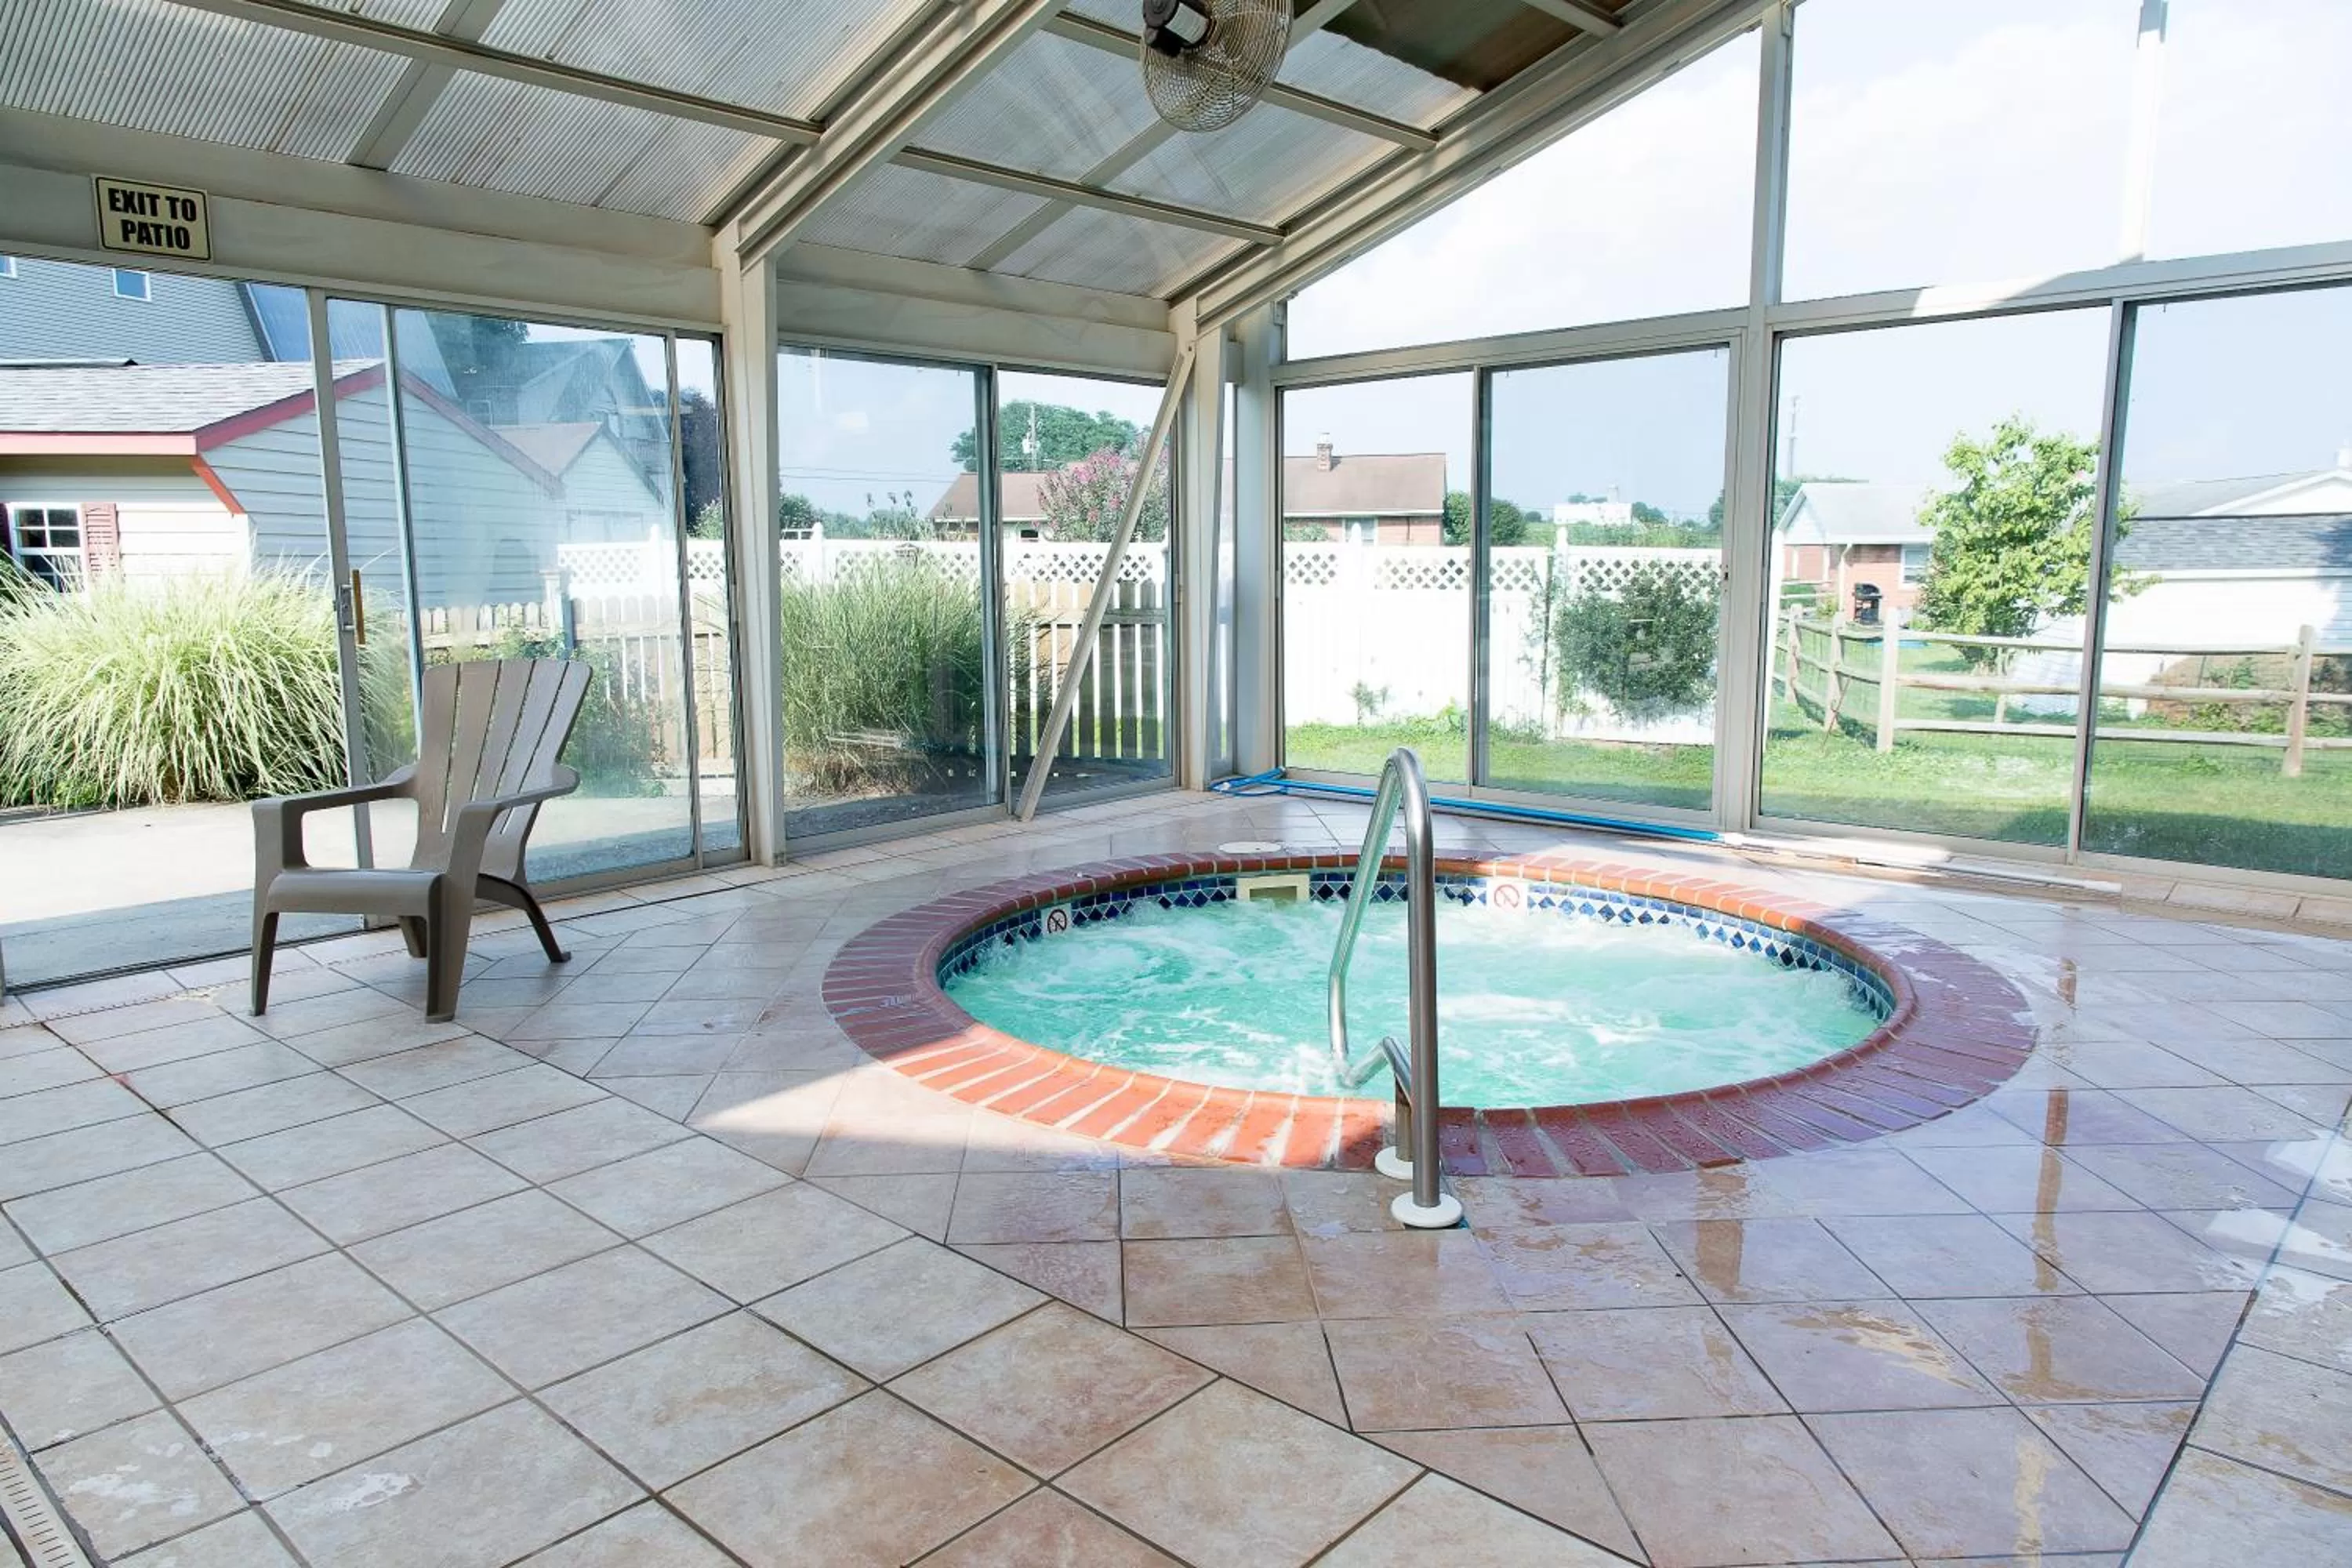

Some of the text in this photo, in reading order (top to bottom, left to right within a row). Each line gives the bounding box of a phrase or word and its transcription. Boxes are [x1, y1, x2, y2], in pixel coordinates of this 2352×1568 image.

[108, 187, 197, 222] EXIT TO
[121, 219, 191, 249] PATIO
